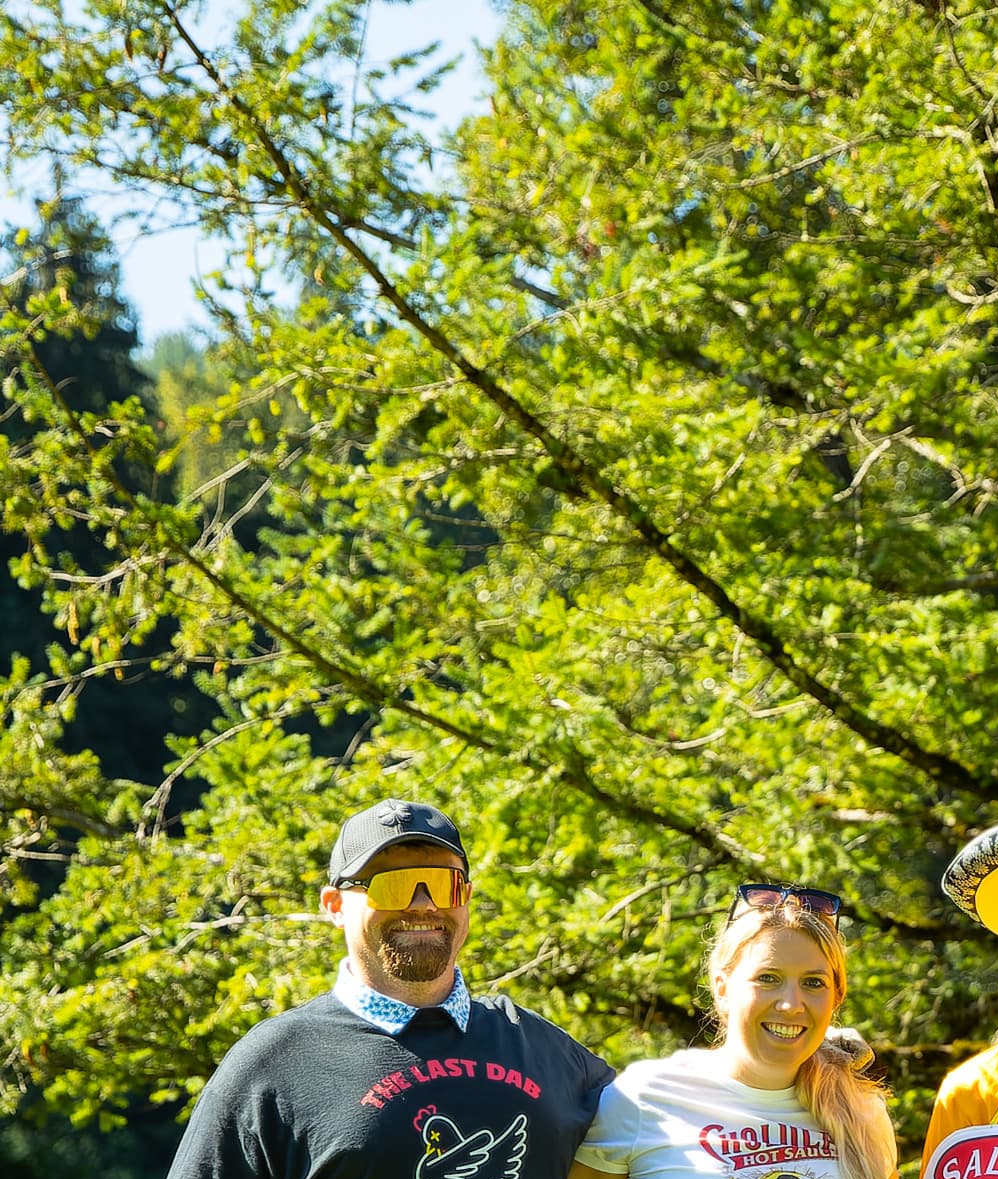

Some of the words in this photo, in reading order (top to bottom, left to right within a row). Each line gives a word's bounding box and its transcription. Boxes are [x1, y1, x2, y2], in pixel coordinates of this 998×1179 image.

[360, 1071, 412, 1109] THE
[410, 1058, 478, 1083] LAST
[486, 1062, 542, 1099] DAB
[743, 1151, 778, 1167] HOT
